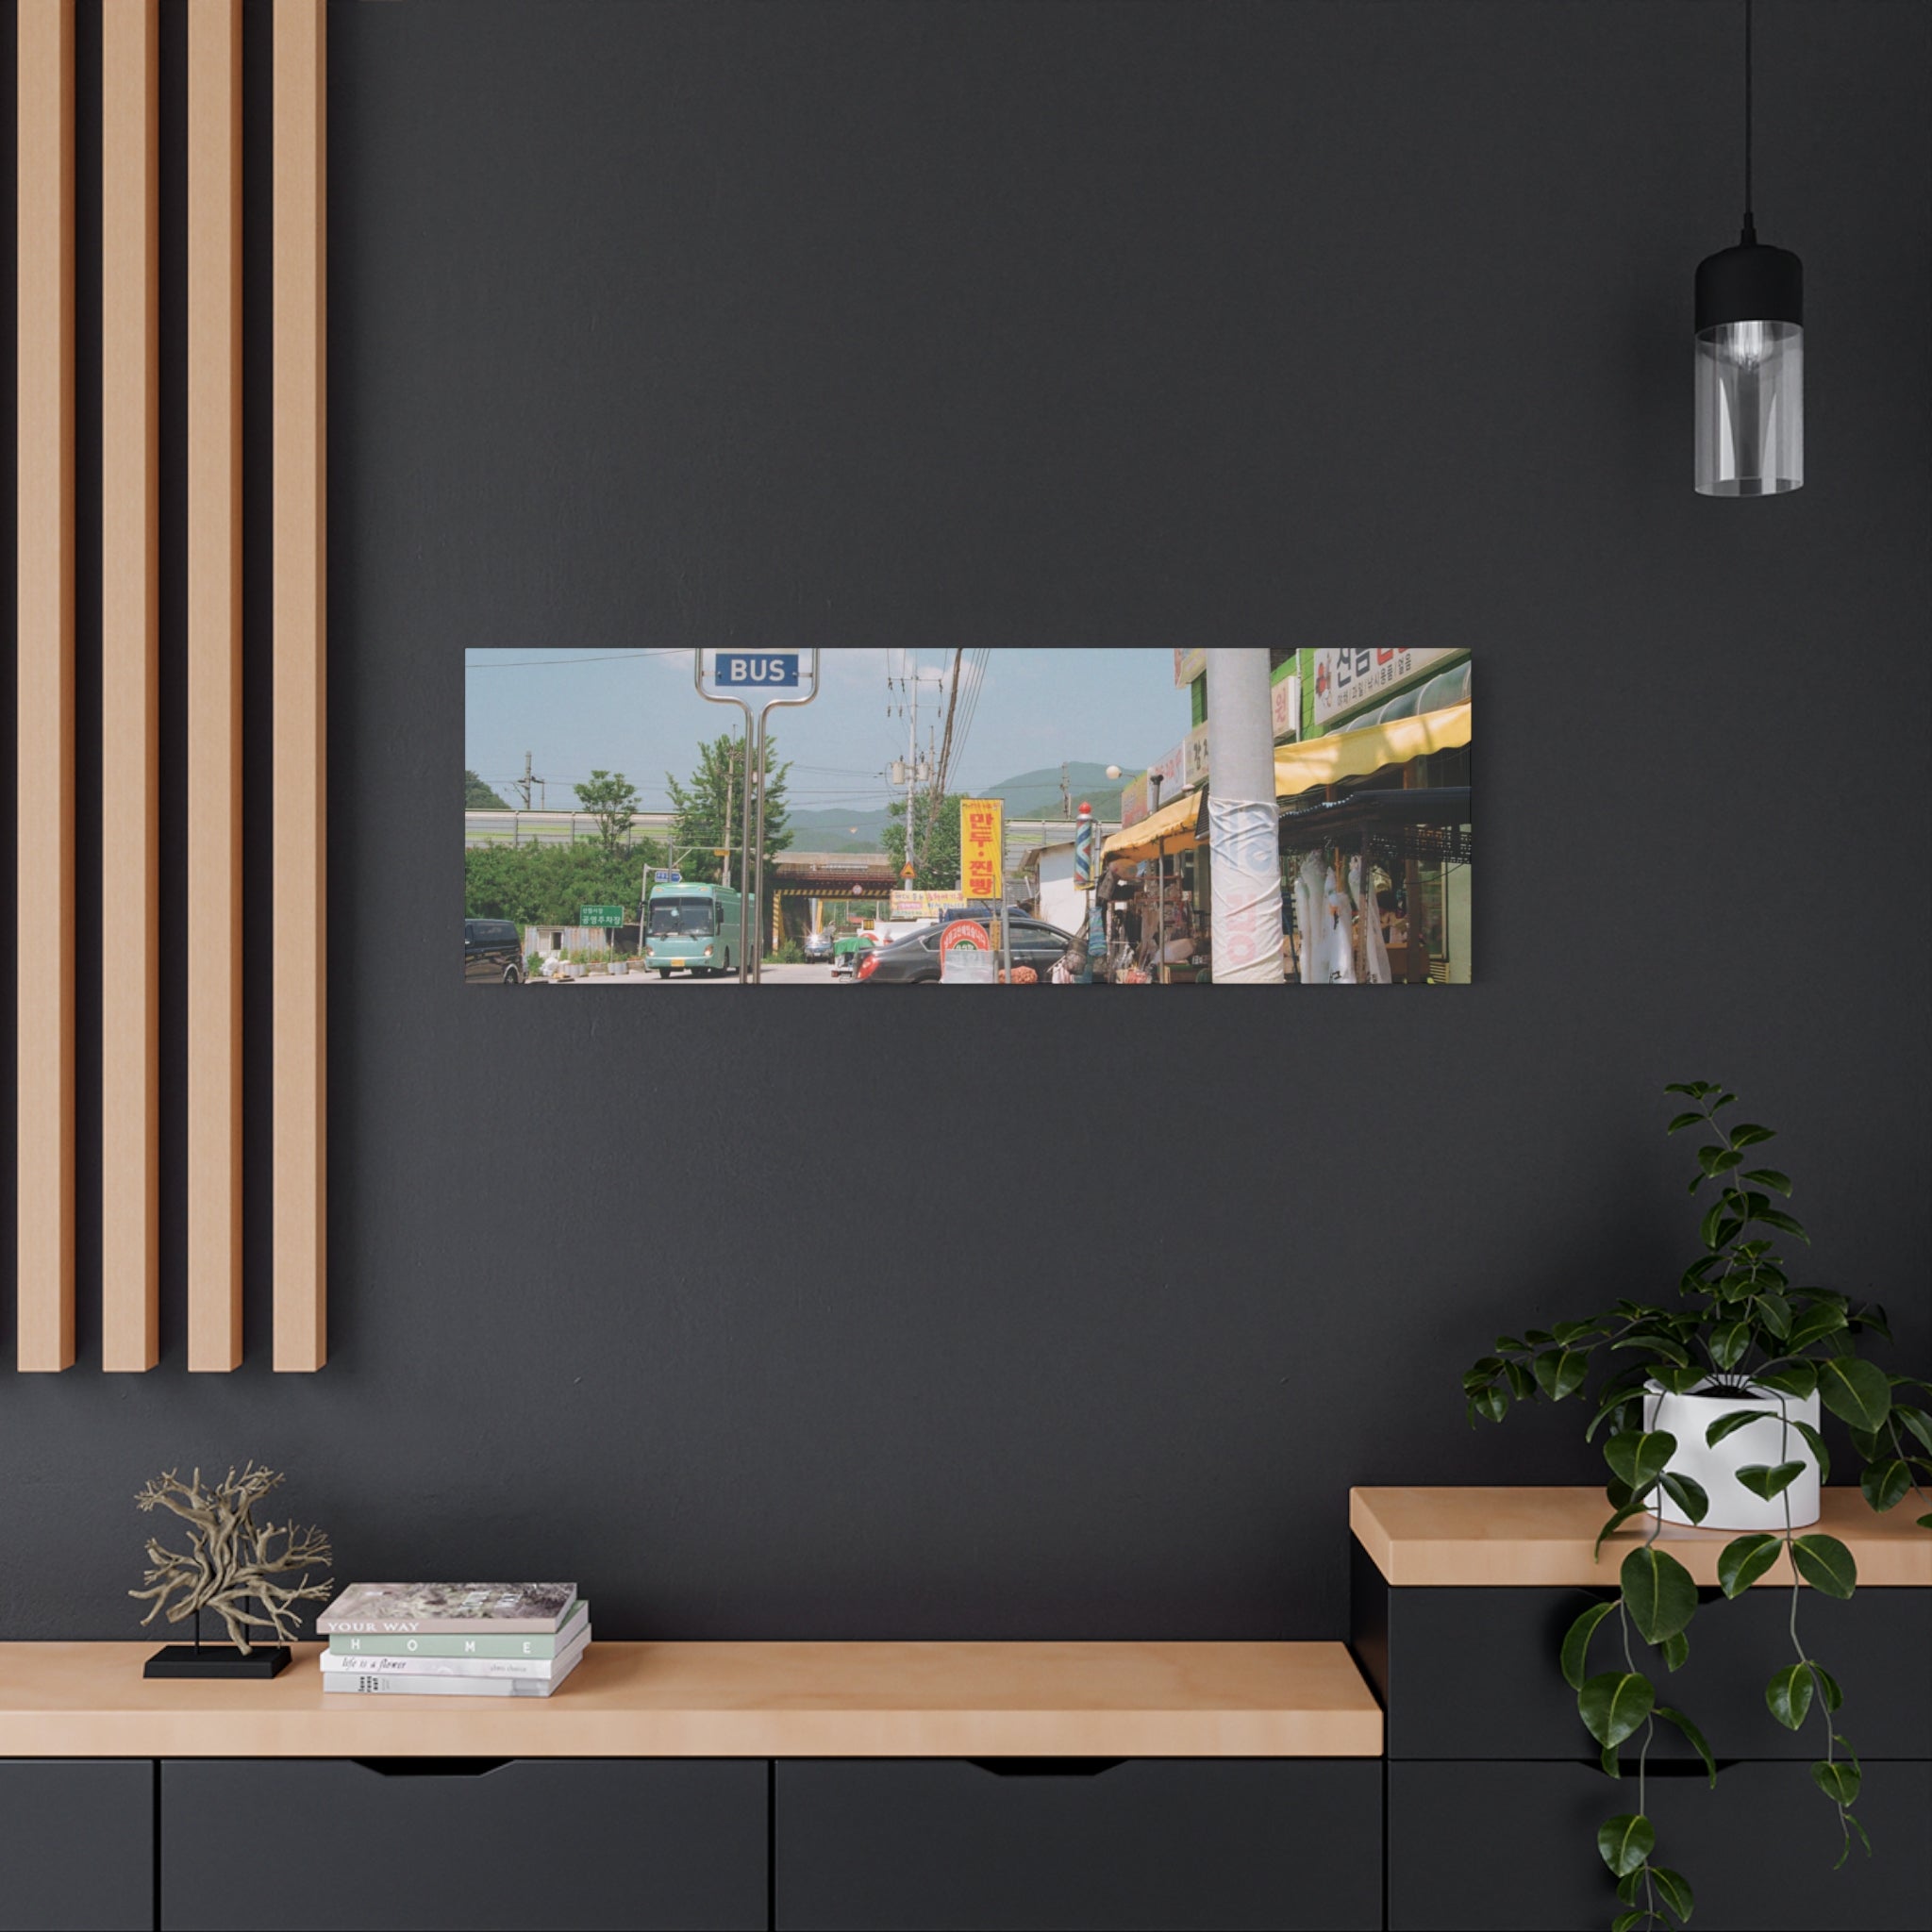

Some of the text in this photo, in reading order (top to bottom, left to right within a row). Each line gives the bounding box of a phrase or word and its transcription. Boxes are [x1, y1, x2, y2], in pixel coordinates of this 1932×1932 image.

[730, 658, 785, 681] BUS
[328, 1622, 420, 1631] YOUR WAY
[351, 1638, 531, 1655] HOME
[342, 1657, 357, 1671] life
[377, 1658, 407, 1672] flower
